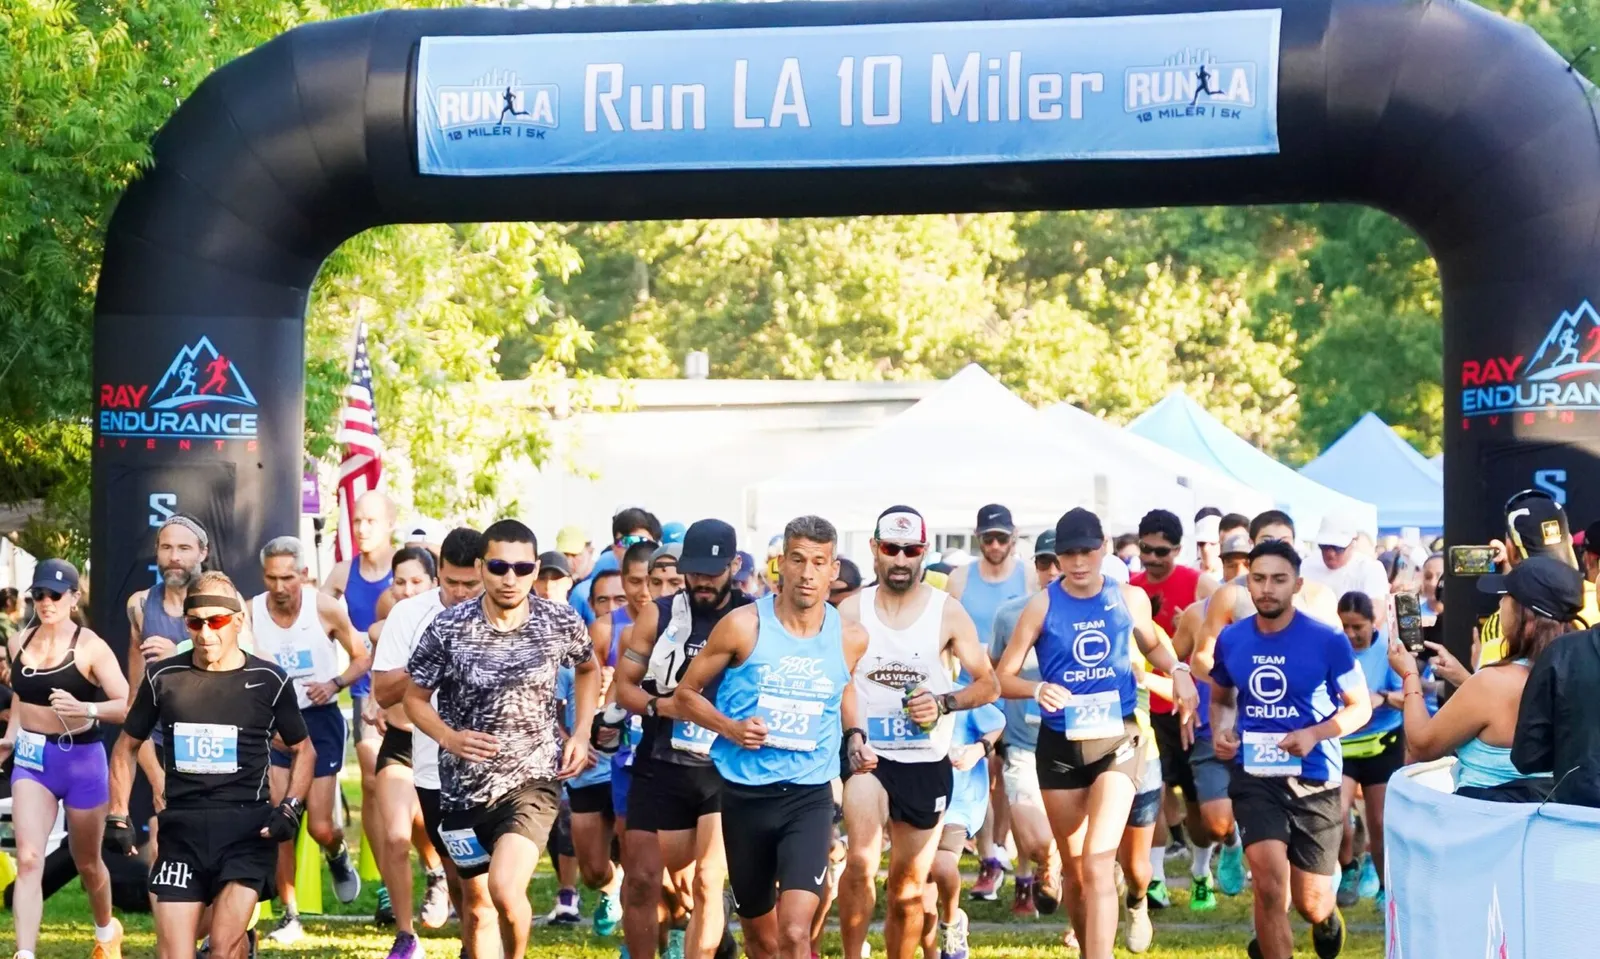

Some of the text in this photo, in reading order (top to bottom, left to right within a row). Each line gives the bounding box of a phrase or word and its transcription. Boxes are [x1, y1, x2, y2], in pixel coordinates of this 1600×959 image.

[585, 51, 1104, 132] Run LA 10 Miler
[1129, 68, 1250, 108] RUN LA
[440, 90, 554, 126] RUN LA
[1137, 112, 1153, 123] 10
[1159, 107, 1206, 119] MILER
[448, 131, 462, 141] 10
[468, 127, 512, 138] MILER
[1461, 356, 1523, 386] RAY
[101, 384, 148, 409] RAY
[100, 411, 258, 433] ENDURANCE
[98, 438, 258, 451] EVENTS
[1073, 619, 1106, 631] TEAM
[774, 655, 825, 678] SBRC
[1252, 655, 1286, 665] TEAM
[874, 673, 922, 682] LAS VEGAS
[1063, 666, 1117, 683] CRUDA
[767, 710, 810, 736] 323
[1075, 704, 1111, 726] 237
[1245, 705, 1300, 719] CRUDA
[17, 739, 36, 760] 302
[185, 736, 224, 759] 165
